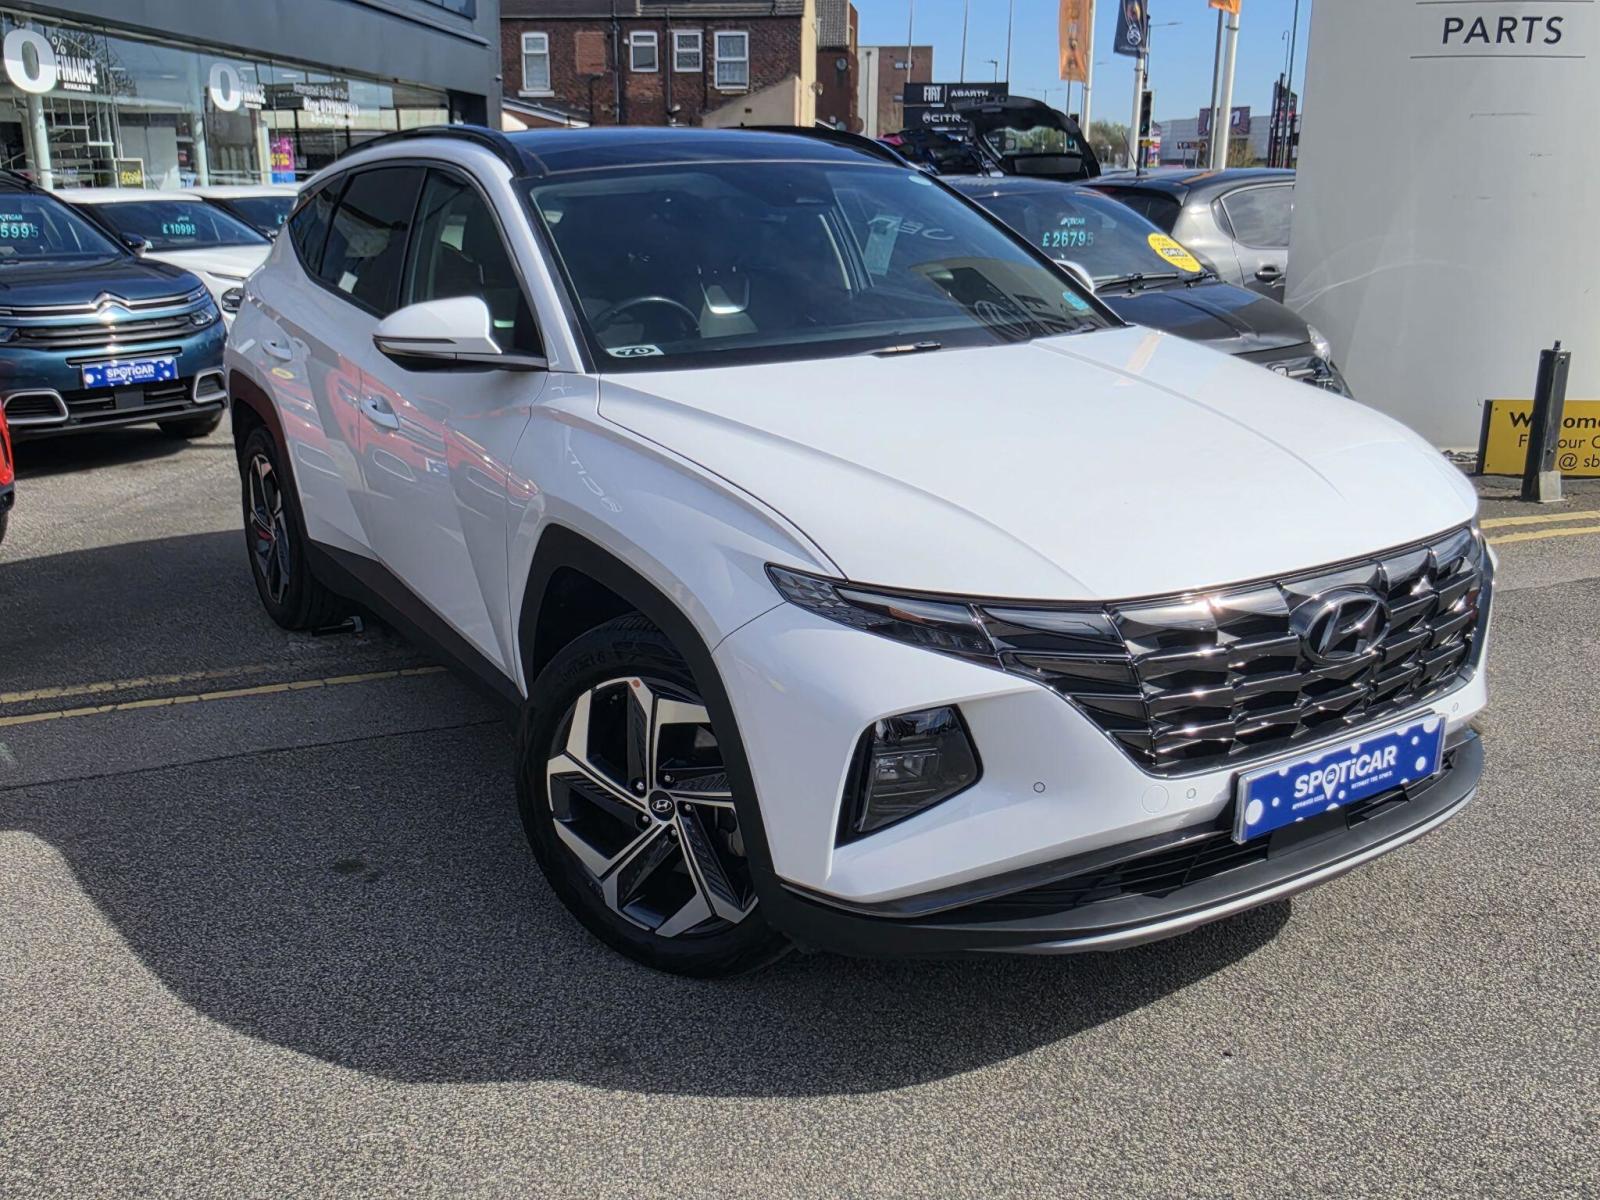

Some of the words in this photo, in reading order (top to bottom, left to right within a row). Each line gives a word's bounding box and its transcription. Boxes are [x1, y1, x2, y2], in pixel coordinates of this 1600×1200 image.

[1441, 15, 1564, 45] PARTS
[56, 54, 98, 84] FINANCE
[923, 86, 942, 102] FIAT
[950, 89, 989, 97] ABARTH
[1559, 452, 1578, 471] @
